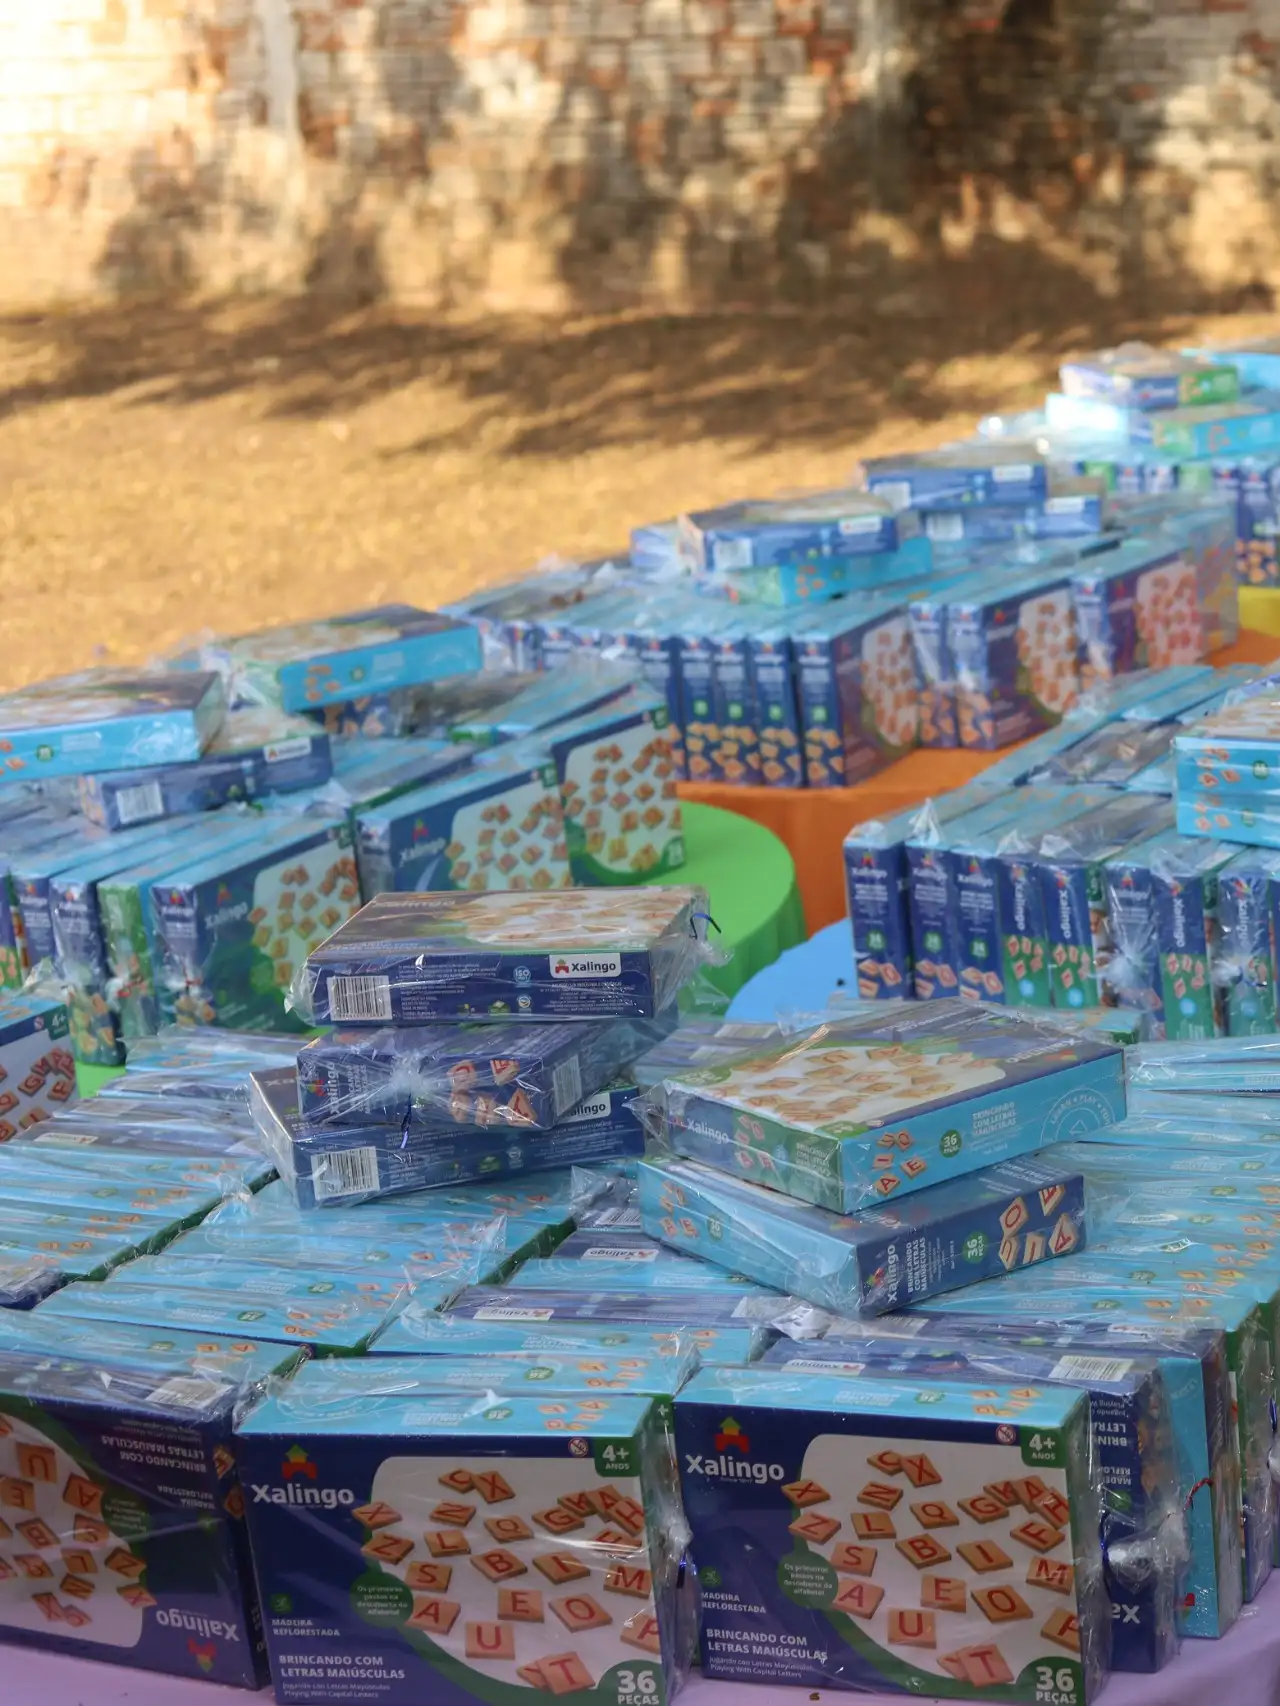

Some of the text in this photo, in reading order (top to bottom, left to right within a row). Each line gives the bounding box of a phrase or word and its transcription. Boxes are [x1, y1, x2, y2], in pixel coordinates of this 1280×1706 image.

[570, 960, 616, 974] Xalingo
[570, 1102, 606, 1116] lingo
[686, 1118, 730, 1144] Xalingo
[944, 1132, 958, 1147] 36
[966, 1238, 978, 1258] 36
[887, 1244, 899, 1304] Xalingo
[1092, 1422, 1126, 1434] LETRA
[1028, 1434, 1056, 1450] 4+
[164, 1444, 205, 1460] LETRAS
[602, 1444, 630, 1462] 4+
[1031, 1452, 1056, 1461] ANOS
[120, 1451, 207, 1473] BRINCANDO COM
[605, 1462, 630, 1470] ANOS
[685, 1454, 785, 1484] Xalingo
[251, 1483, 354, 1510] Xalingo
[701, 1592, 740, 1602] MADEIRA
[702, 1600, 766, 1614] REFLORESTADA
[156, 1608, 240, 1642] Xalingo
[272, 1618, 312, 1626] MADEIRA
[273, 1628, 340, 1637] REFLORESTADA
[706, 1628, 808, 1646] BRINCANDO COM
[708, 1642, 828, 1660] LETRAS MAIÚSCULAS
[278, 1655, 384, 1666] BRINCANDO COM
[281, 1666, 406, 1679] LETRAS MAIÚSCULAS
[736, 1666, 752, 1674] With
[617, 1670, 656, 1694] 36
[1036, 1665, 1075, 1692] 36
[617, 1694, 660, 1706] PEÇAS
[1036, 1691, 1078, 1706] PEÇAS
